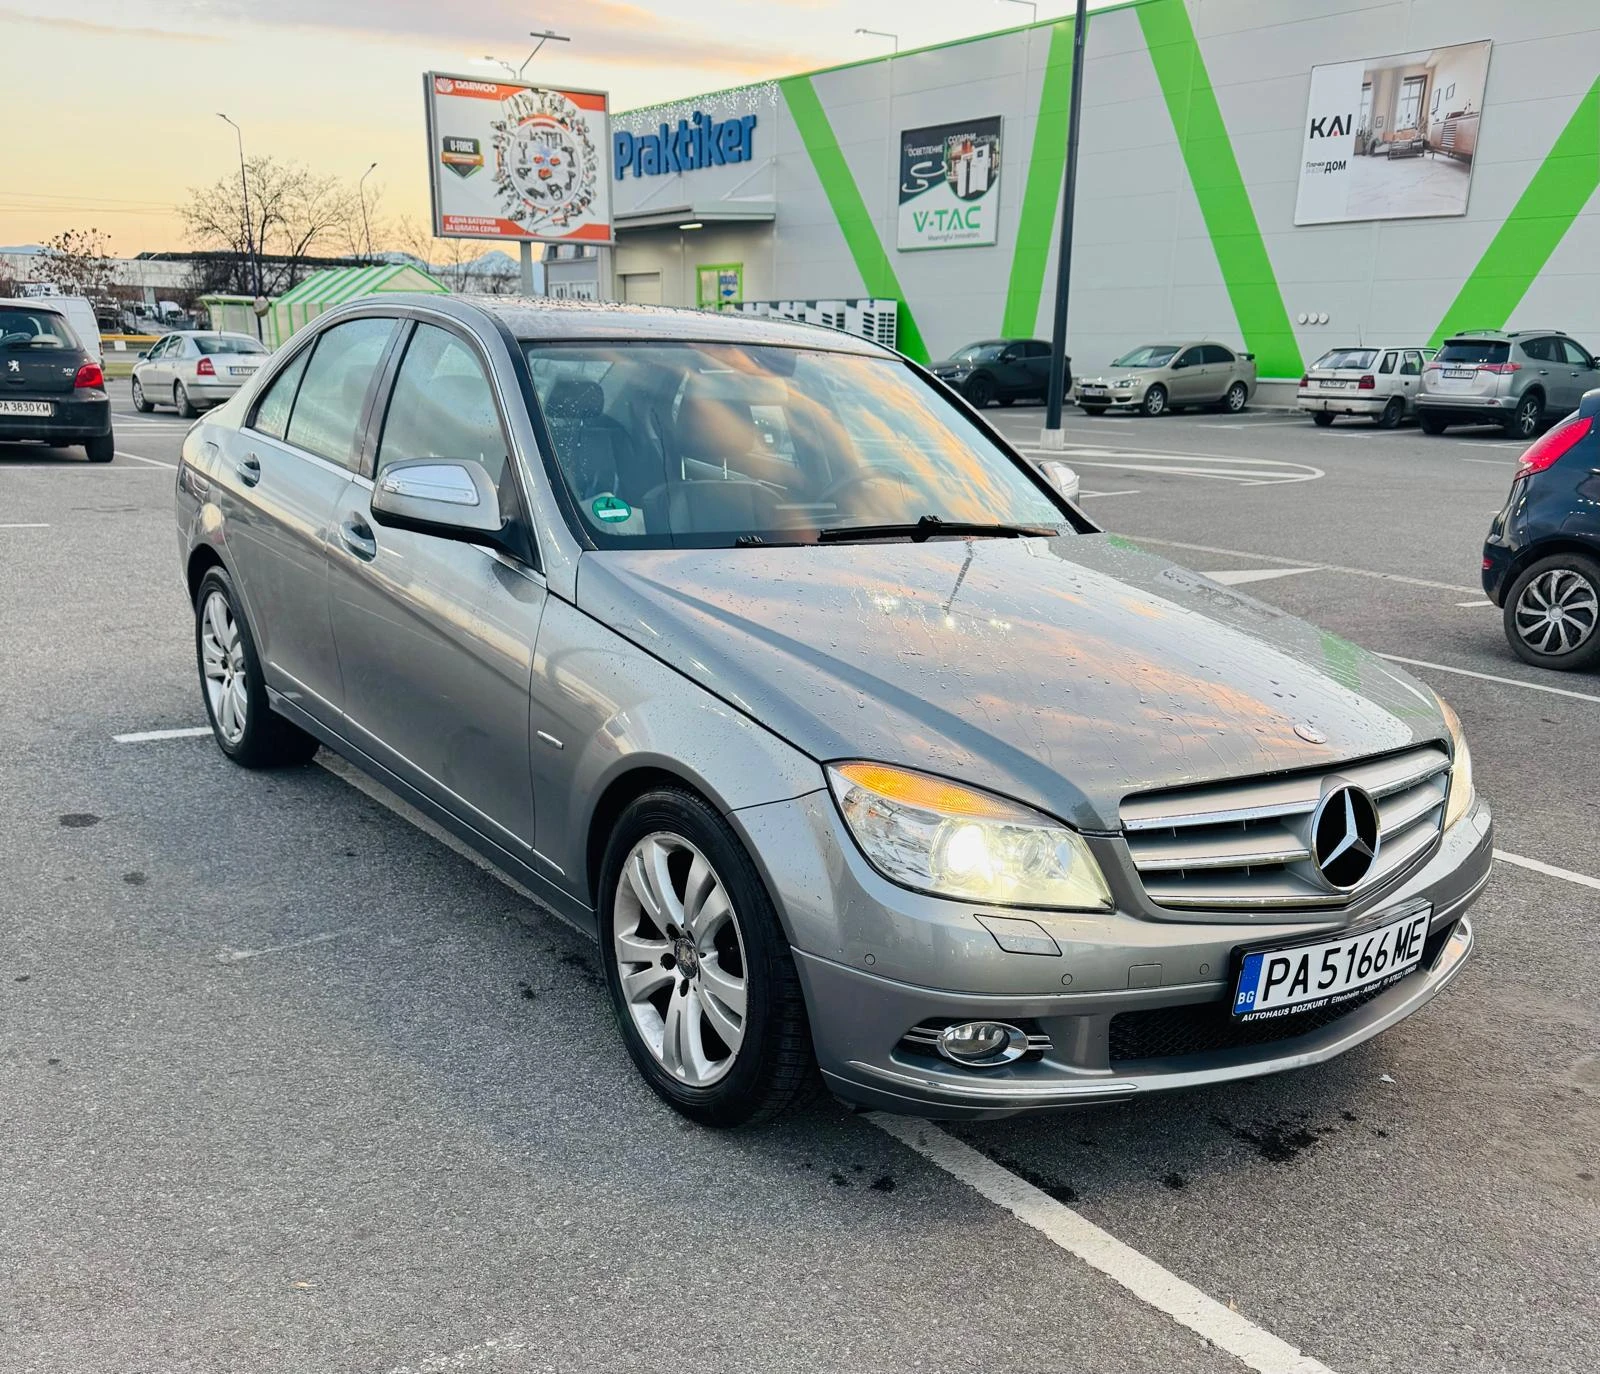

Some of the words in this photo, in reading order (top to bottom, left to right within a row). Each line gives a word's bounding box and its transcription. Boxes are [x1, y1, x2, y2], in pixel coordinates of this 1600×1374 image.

[455, 80, 497, 93] DAEWOO
[1310, 114, 1352, 139] KAI
[450, 140, 474, 153] U-FORCE
[613, 111, 756, 180] Praktiker
[1324, 160, 1347, 174] ДОМ
[467, 217, 496, 225] БАТЕРИЯ
[11, 402, 35, 412] 3830
[35, 403, 49, 413] KM
[605, 497, 616, 509] 4
[1262, 953, 1309, 1002] PA
[1317, 932, 1390, 990] 5166
[1391, 916, 1426, 967] ME
[1238, 991, 1256, 1005] BG
[1241, 1007, 1290, 1022] AUTOHAUS
[1290, 998, 1329, 1015] BOZKURT
[1331, 990, 1360, 1004] Ettenheim
